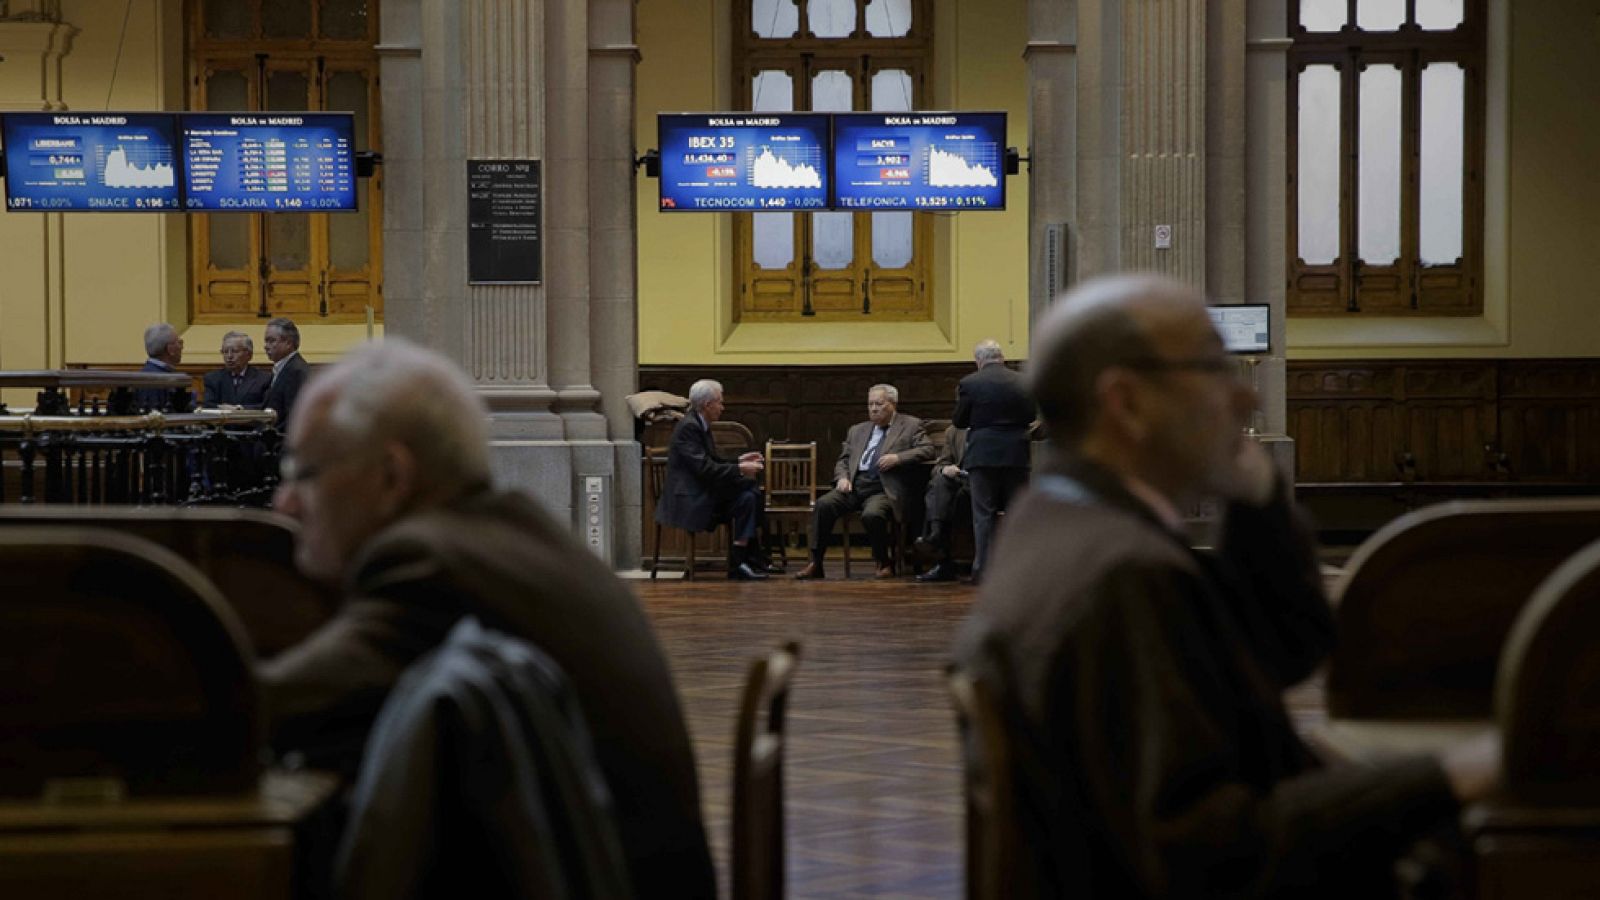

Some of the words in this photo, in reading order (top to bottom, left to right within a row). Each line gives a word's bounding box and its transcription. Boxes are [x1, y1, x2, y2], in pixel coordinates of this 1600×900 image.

[54, 117, 80, 125] BOLSA
[91, 117, 126, 125] MADRID
[885, 117, 912, 125] BOLSA
[922, 117, 957, 125] MADRID
[688, 136, 716, 148] IBEX
[719, 136, 735, 148] 35
[88, 198, 129, 207] SNIACE
[219, 198, 267, 208] SOLARIA
[275, 198, 302, 208] 1,140
[694, 198, 755, 208] TECNOCOM
[760, 198, 786, 208] 1,440
[840, 197, 907, 207] TELEFONICA
[915, 197, 948, 207] 13,525
